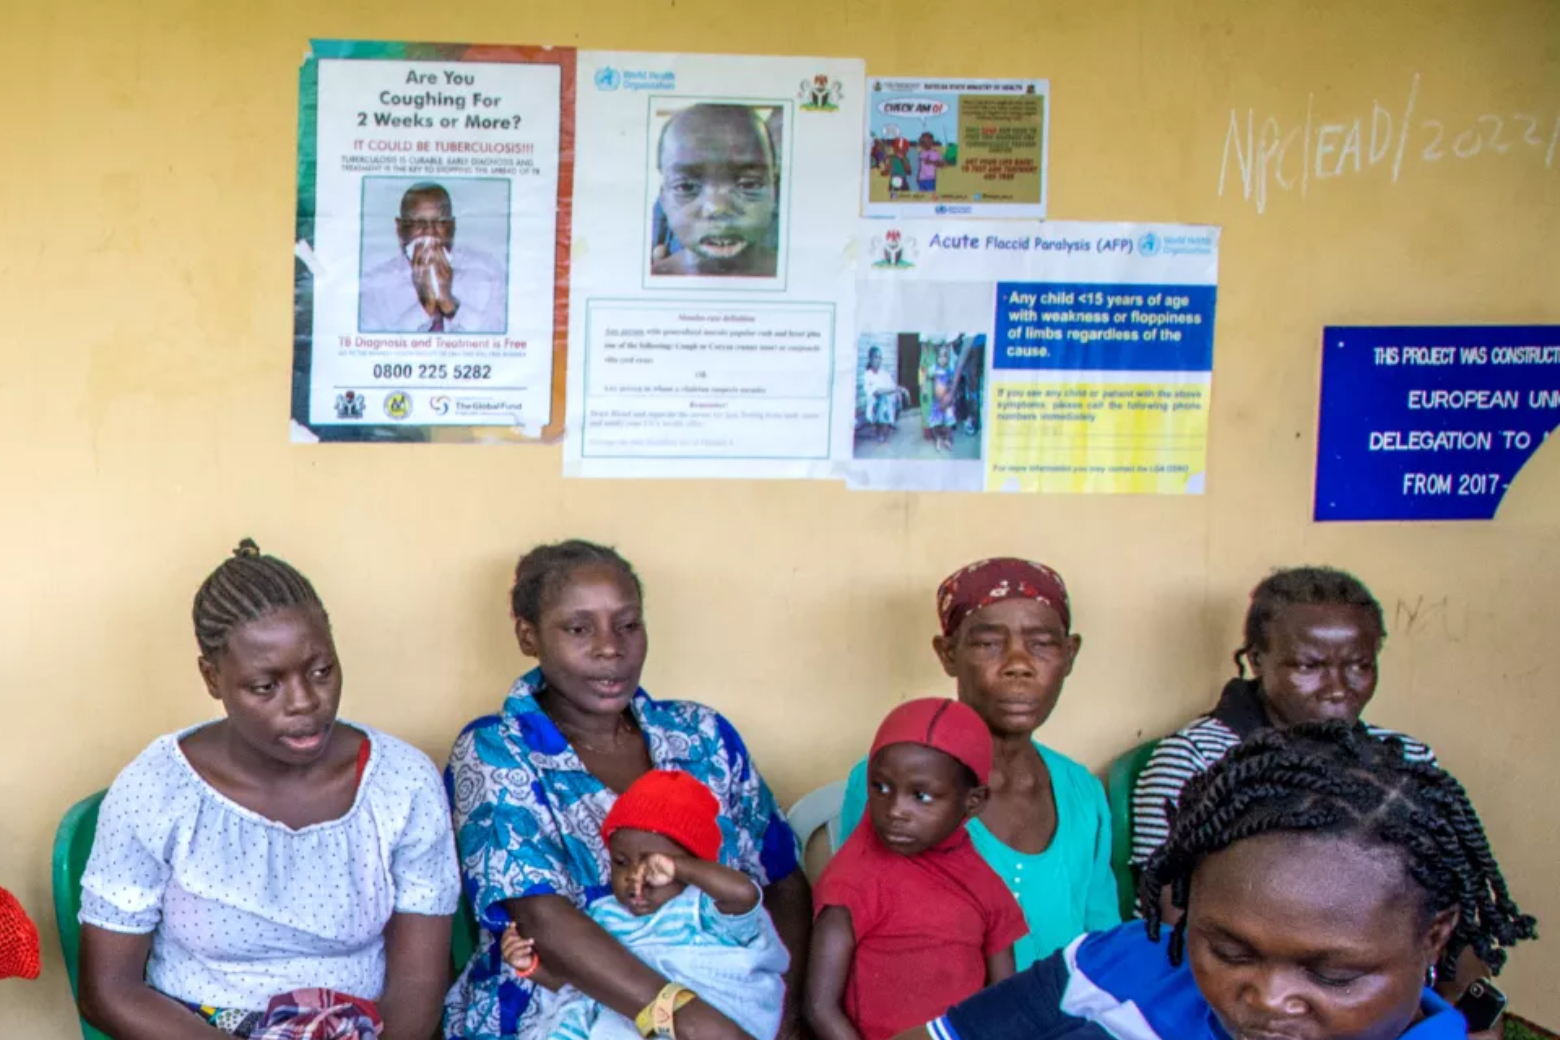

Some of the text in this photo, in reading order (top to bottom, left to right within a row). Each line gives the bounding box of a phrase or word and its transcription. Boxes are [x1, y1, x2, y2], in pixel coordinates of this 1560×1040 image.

[405, 69, 475, 85] Are You
[379, 90, 502, 110] Coughing For
[884, 103, 915, 113] CHECK
[915, 103, 931, 113] AM
[357, 112, 522, 130] 2 Weeks or More?
[353, 140, 534, 154] IT COULD BE TUBERCULOSIS!!!
[929, 232, 1133, 254] Acute Flaccid Paralysis (AFP)
[1008, 291, 1189, 309] Any child <15 years of age
[1008, 309, 1202, 327] with weakness or floppiness
[339, 336, 527, 350] TB Diagnosis and Treatment is Free
[1007, 326, 1182, 343] of limbs regardless of the
[1006, 345, 1050, 357] cause.
[1373, 346, 1560, 365] THIS PROJECT WAS CONSTRUCT
[373, 363, 492, 380] 0800 225 5282
[1407, 390, 1560, 409] EUROPEAN UNI
[1368, 431, 1531, 451] DELEGATION TO
[1402, 473, 1452, 495] FROM
